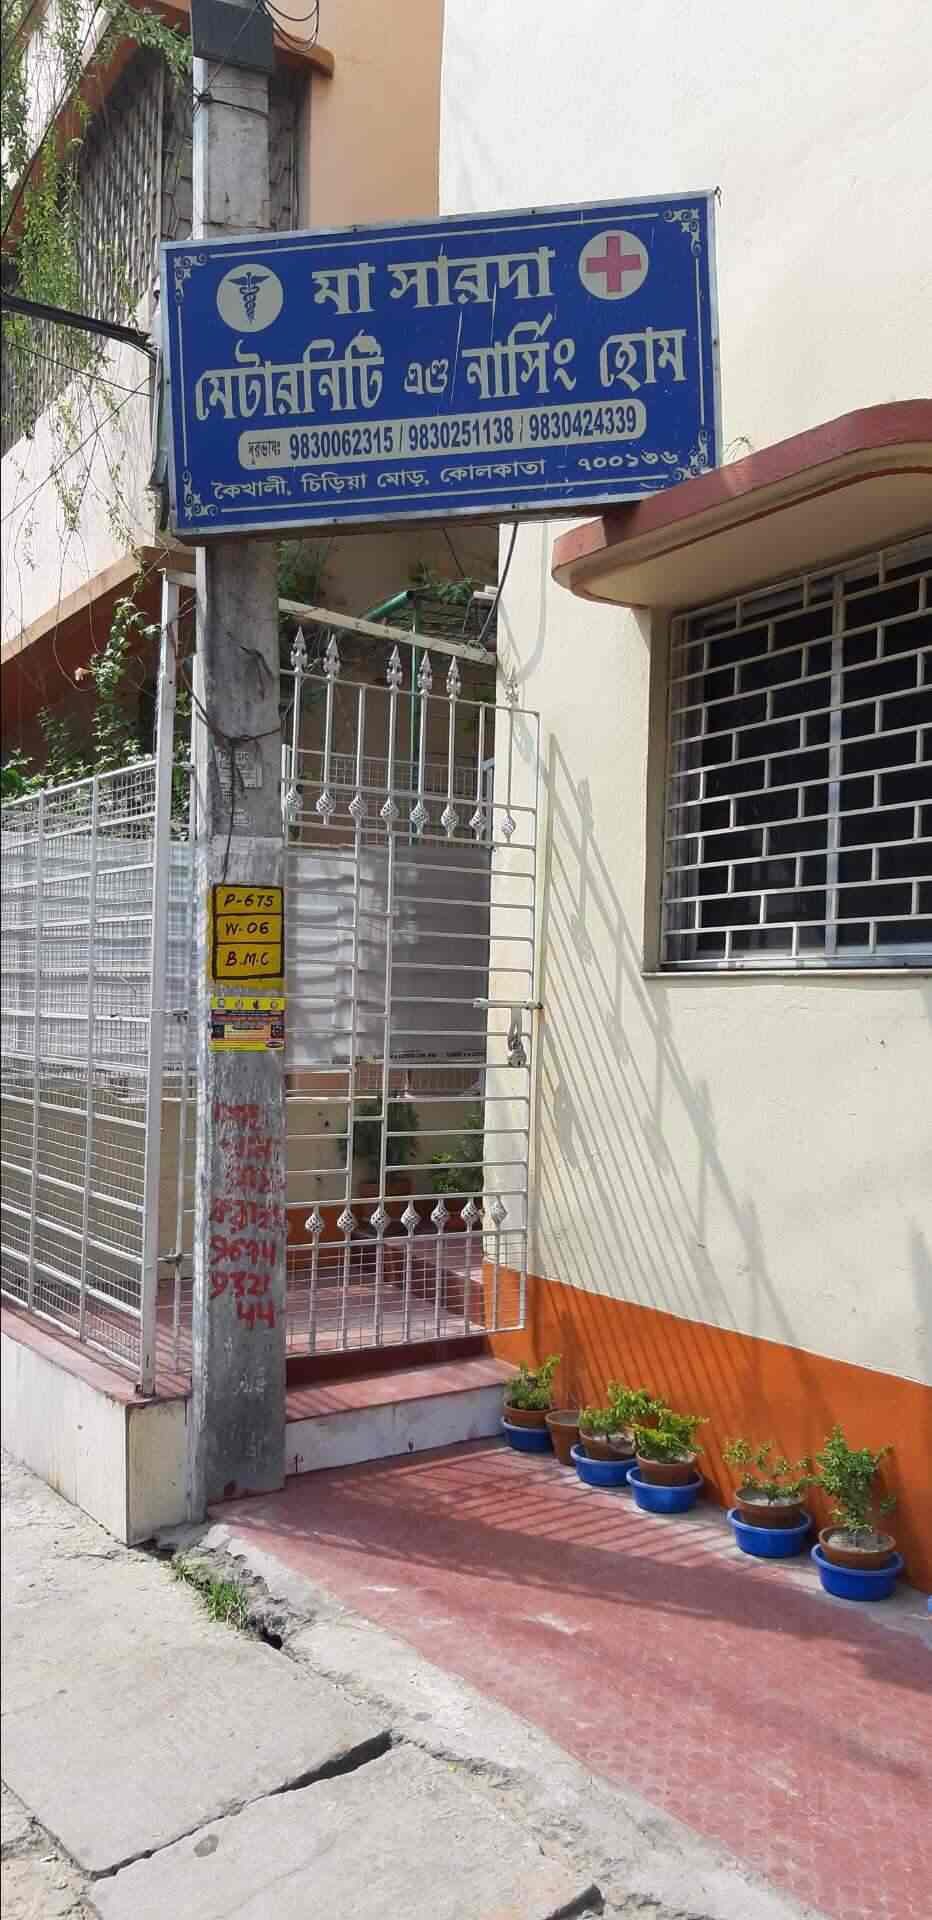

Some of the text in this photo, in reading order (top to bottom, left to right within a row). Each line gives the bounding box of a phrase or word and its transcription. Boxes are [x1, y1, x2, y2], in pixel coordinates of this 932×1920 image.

[311, 245, 556, 316] মা সারদা
[194, 329, 385, 421] মেটারনিটি
[461, 312, 577, 400] নার্সিং
[599, 326, 688, 393] হোম
[289, 426, 394, 461] 9830062315
[408, 415, 514, 451] 9830251138
[529, 405, 637, 441] 9830424339
[440, 458, 546, 482] কোলকাতা
[223, 893, 275, 908] P-675
